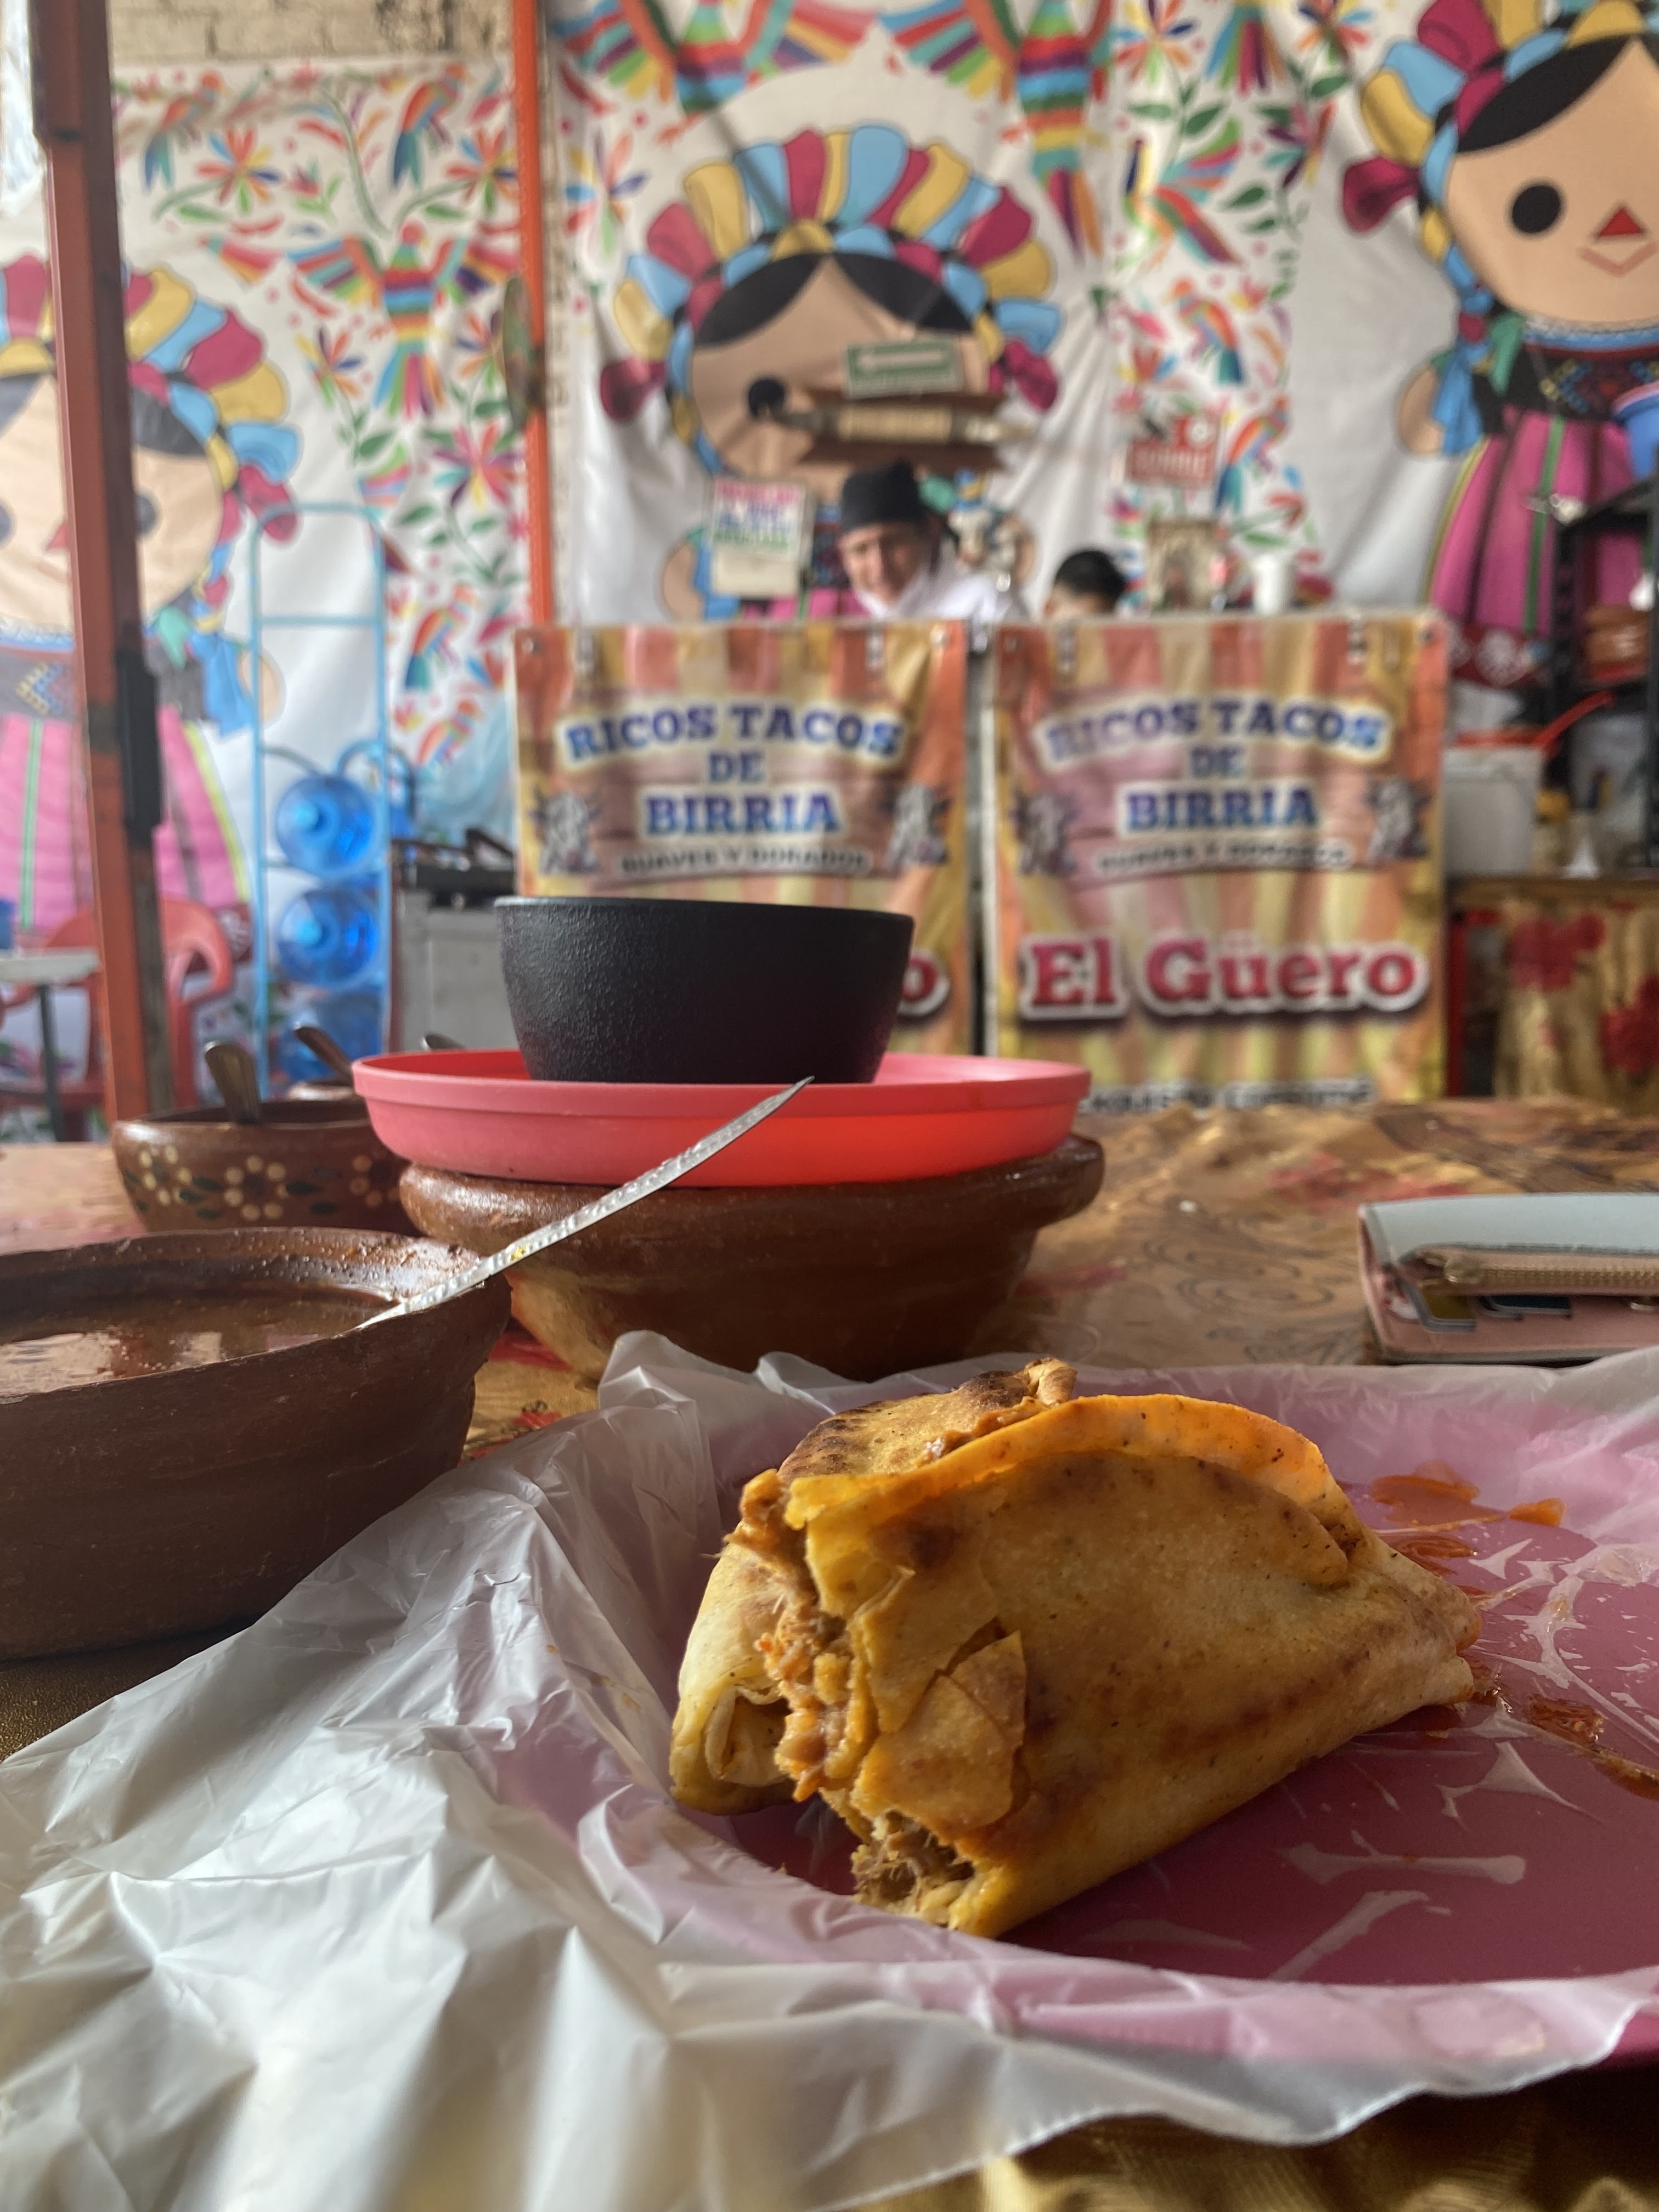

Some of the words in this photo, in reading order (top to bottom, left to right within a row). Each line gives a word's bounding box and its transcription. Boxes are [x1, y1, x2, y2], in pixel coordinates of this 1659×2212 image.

[565, 706, 718, 763] RICOS
[729, 705, 901, 757] TACOS
[1046, 702, 1200, 761] RICOS
[1211, 701, 1381, 748] TACOS
[708, 751, 763, 783] DE
[1190, 745, 1243, 777] DE
[645, 794, 839, 834] BIRRIA
[1127, 787, 1316, 830] BIRRIA
[1030, 936, 1115, 1005] El
[1144, 927, 1417, 1002] Güero
